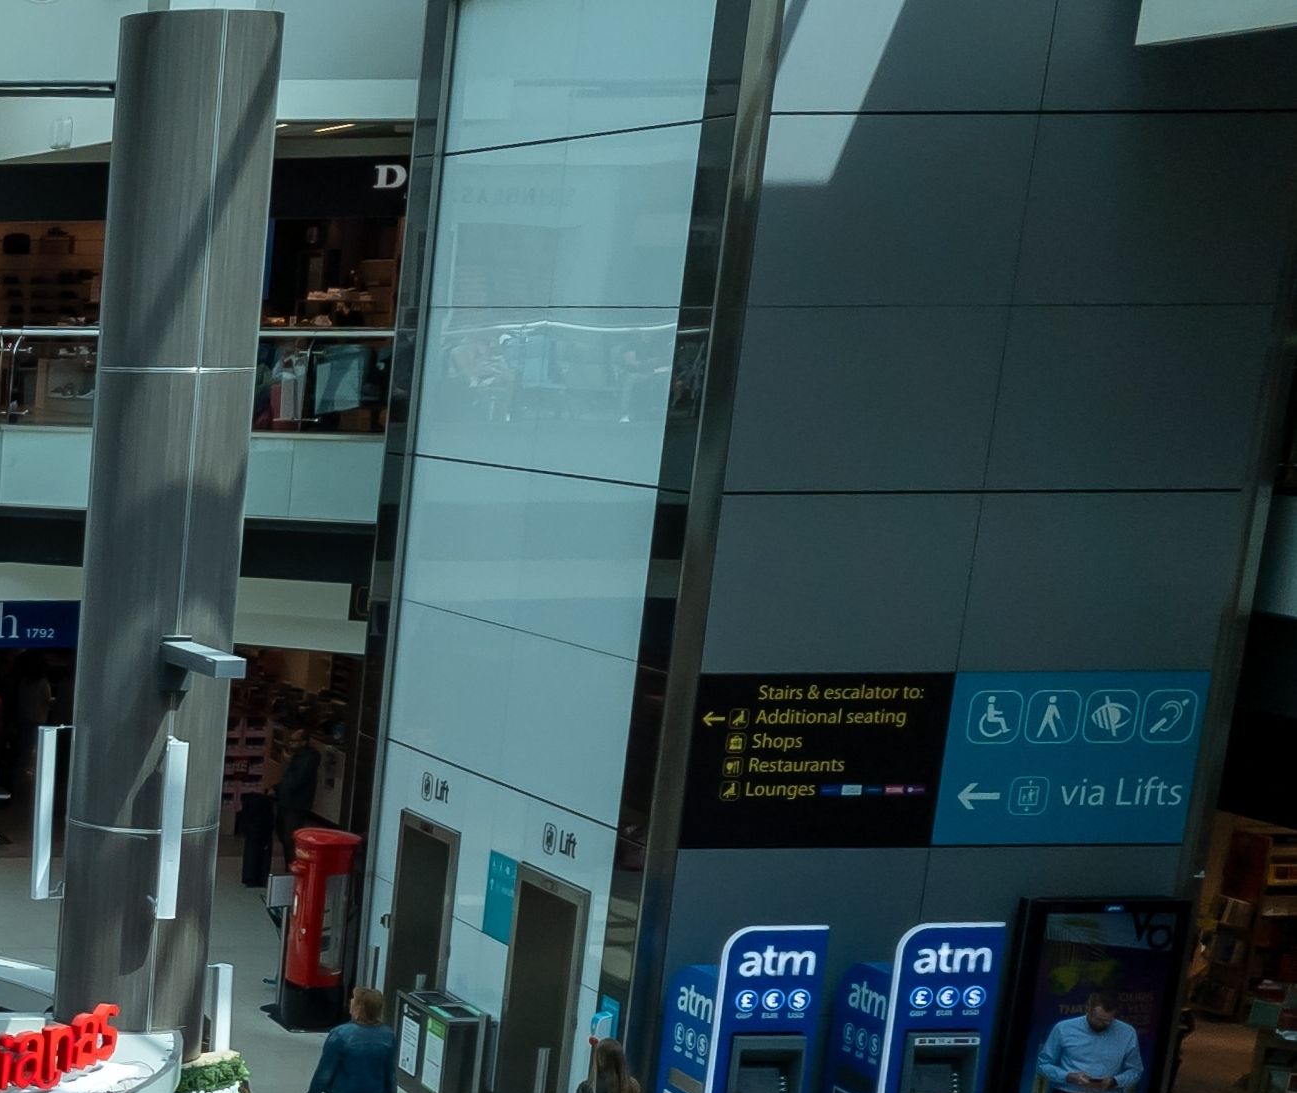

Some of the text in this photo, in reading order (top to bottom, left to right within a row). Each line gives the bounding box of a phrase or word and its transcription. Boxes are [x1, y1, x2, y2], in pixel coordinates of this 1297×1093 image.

[373, 165, 407, 188] D
[26, 628, 54, 639] 1792
[758, 684, 924, 700] Stairs & escalator to:
[755, 708, 907, 728] Additional seating
[752, 733, 803, 752] Shops
[749, 758, 845, 773] Restaurants
[434, 778, 449, 805] Lift
[745, 782, 816, 800] Lounges
[1061, 776, 1183, 806] via Lifts
[559, 830, 577, 859] Lift
[739, 945, 816, 977] atm
[913, 943, 993, 974] atm
[677, 985, 713, 1024] atm
[848, 981, 886, 1020] atm
